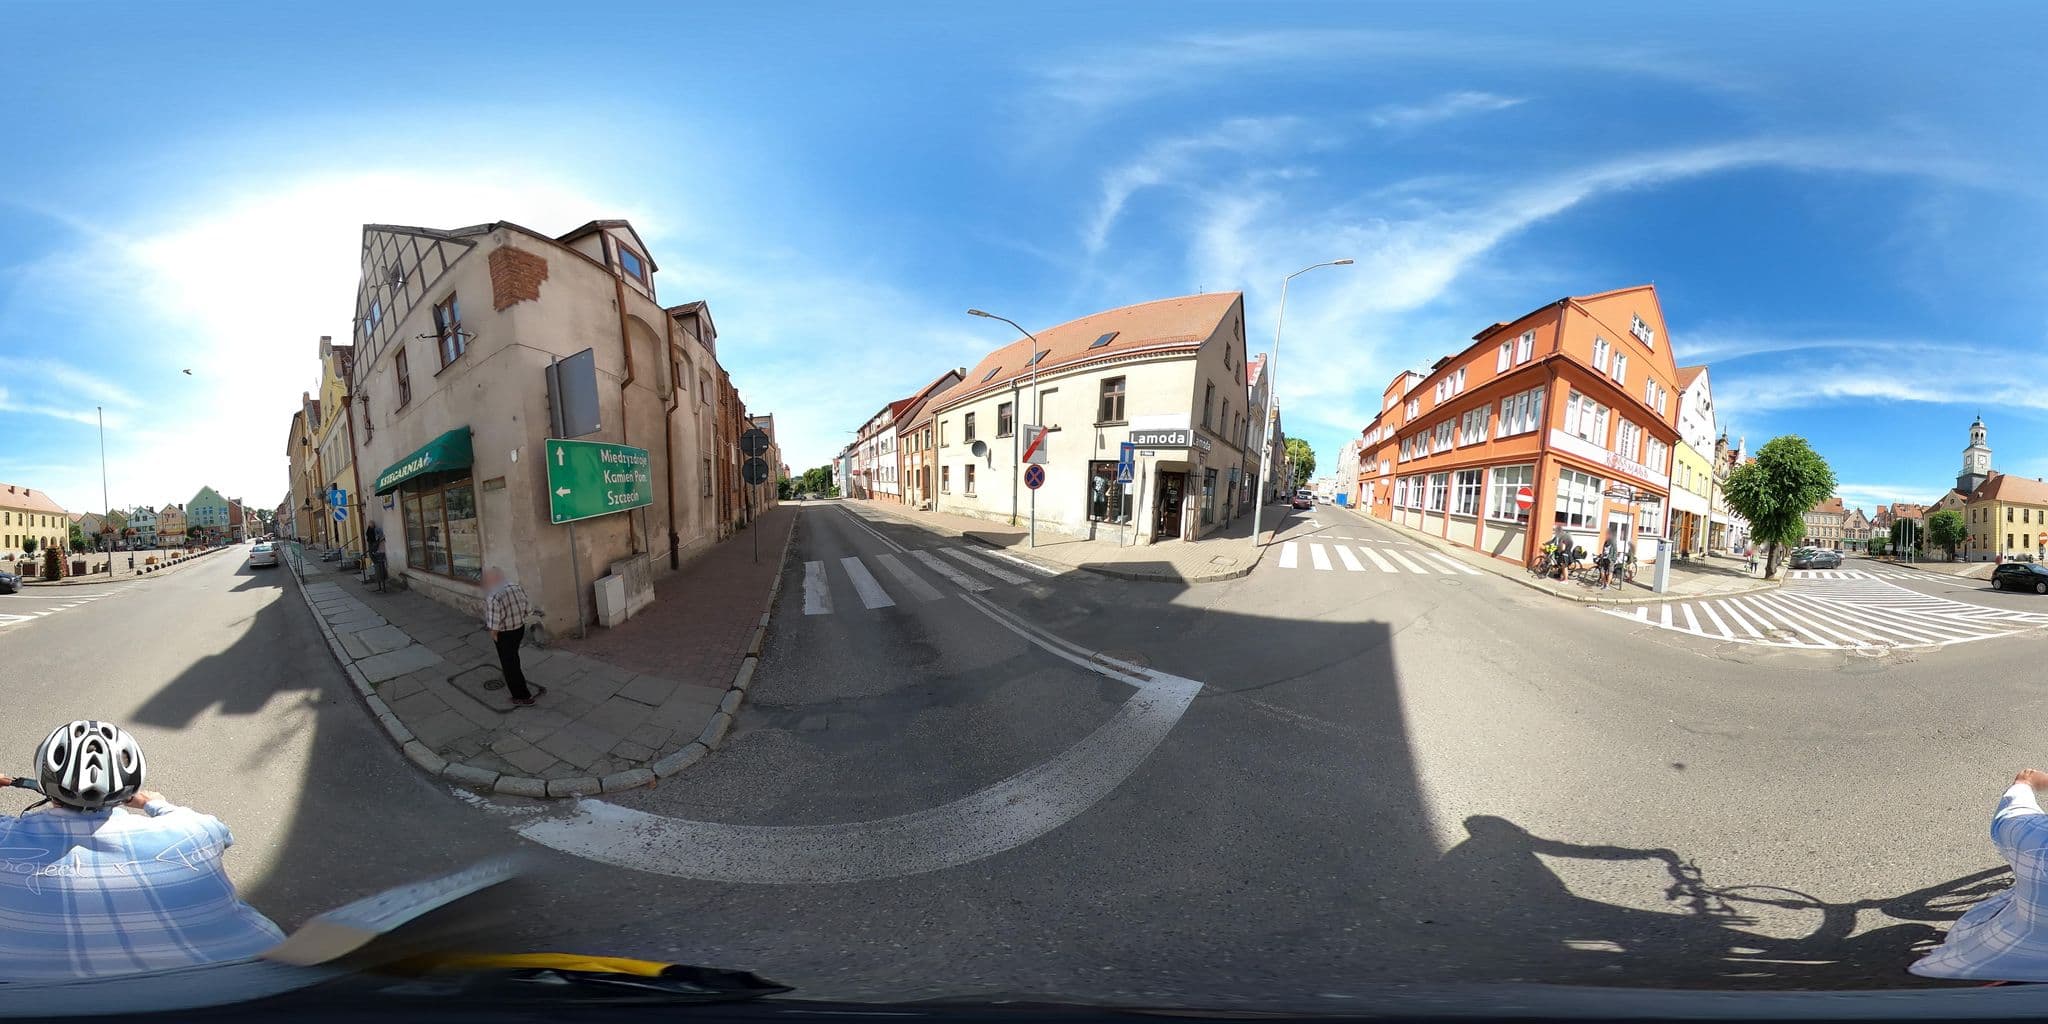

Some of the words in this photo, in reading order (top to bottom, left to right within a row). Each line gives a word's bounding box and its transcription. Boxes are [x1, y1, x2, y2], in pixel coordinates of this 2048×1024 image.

[1131, 431, 1185, 444] Lamoda
[600, 448, 648, 467] Międzyzdroje
[608, 490, 640, 506] Szczecin
